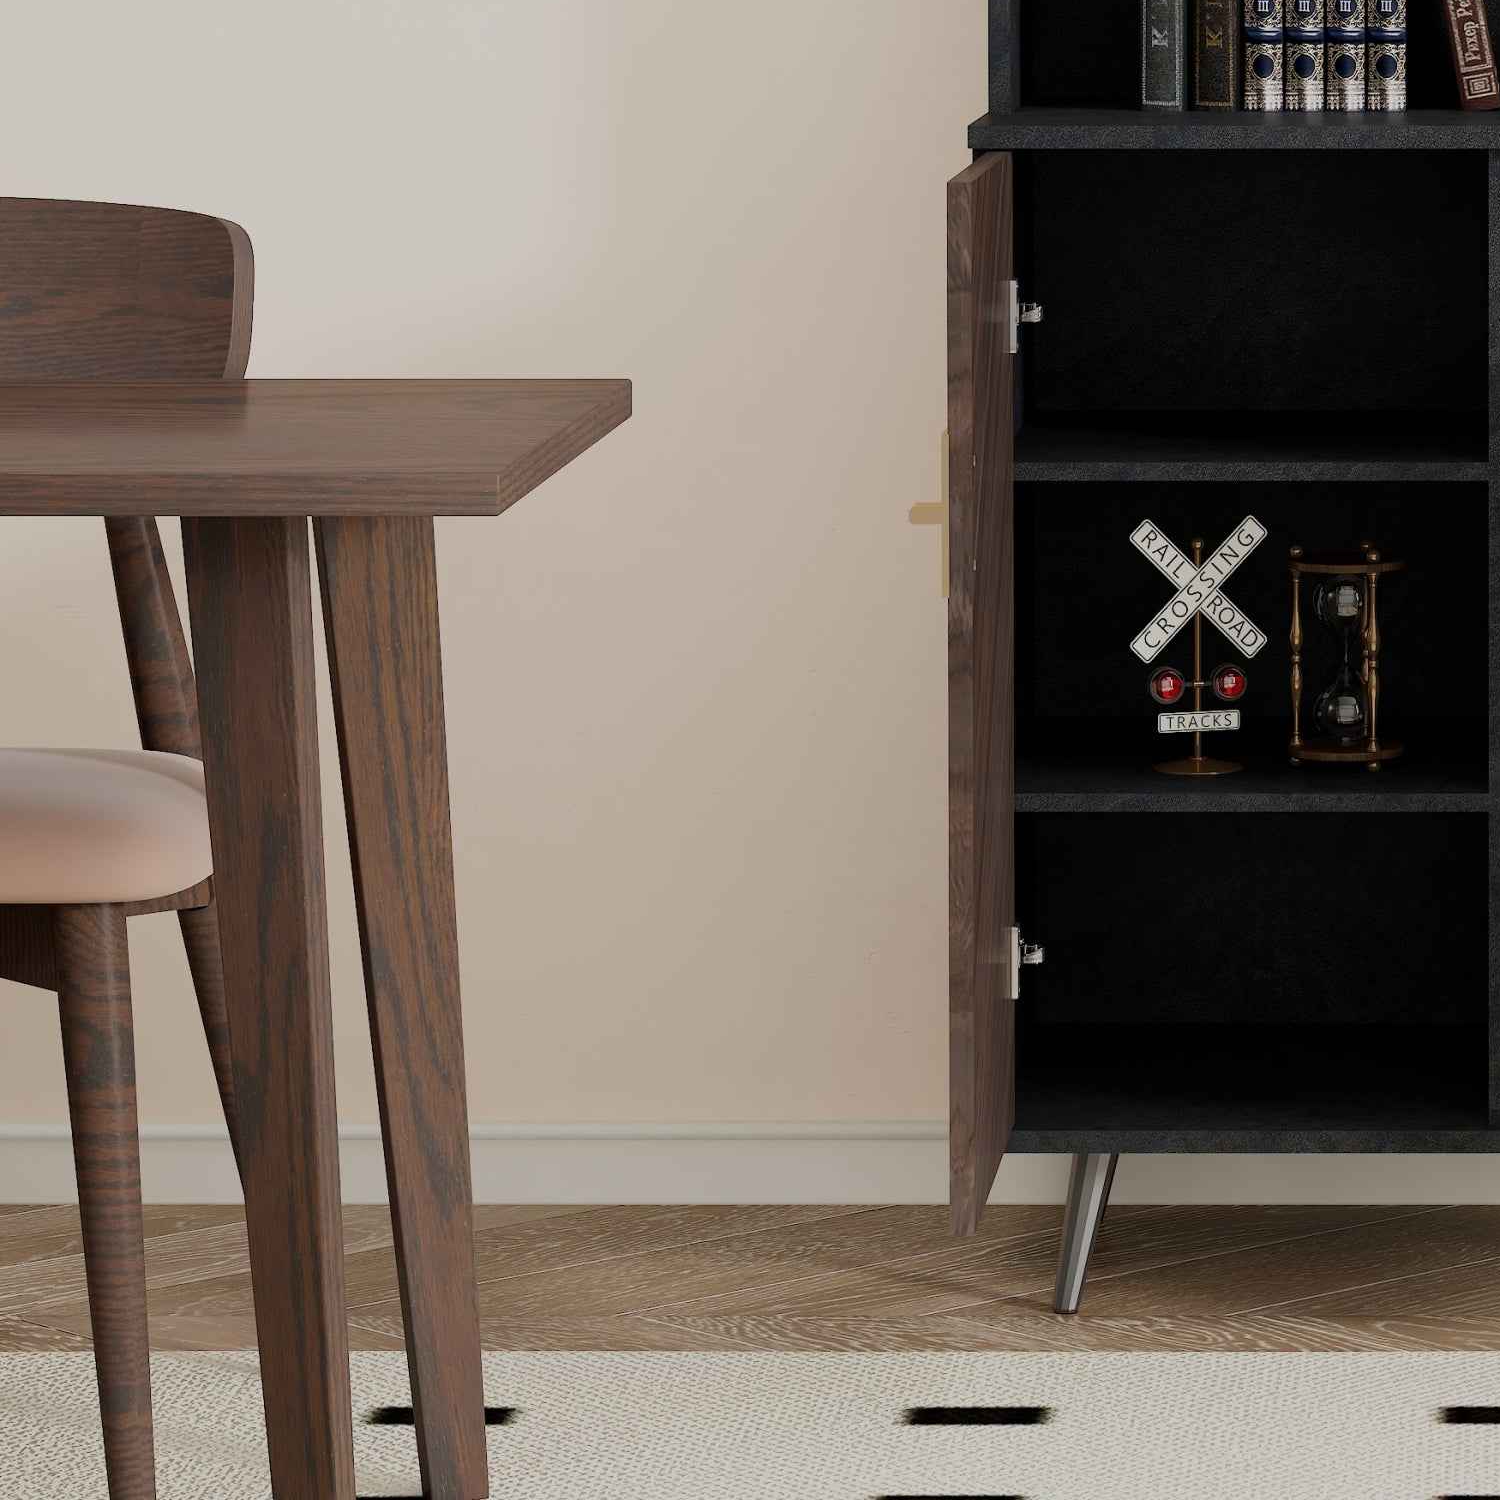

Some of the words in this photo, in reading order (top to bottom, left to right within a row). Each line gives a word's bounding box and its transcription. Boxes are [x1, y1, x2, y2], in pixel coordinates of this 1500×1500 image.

[1141, 529, 1185, 579] RAIL
[1206, 595, 1258, 648] ROAD
[1144, 528, 1255, 649] CROSSING
[1166, 713, 1232, 729] TRACKS
